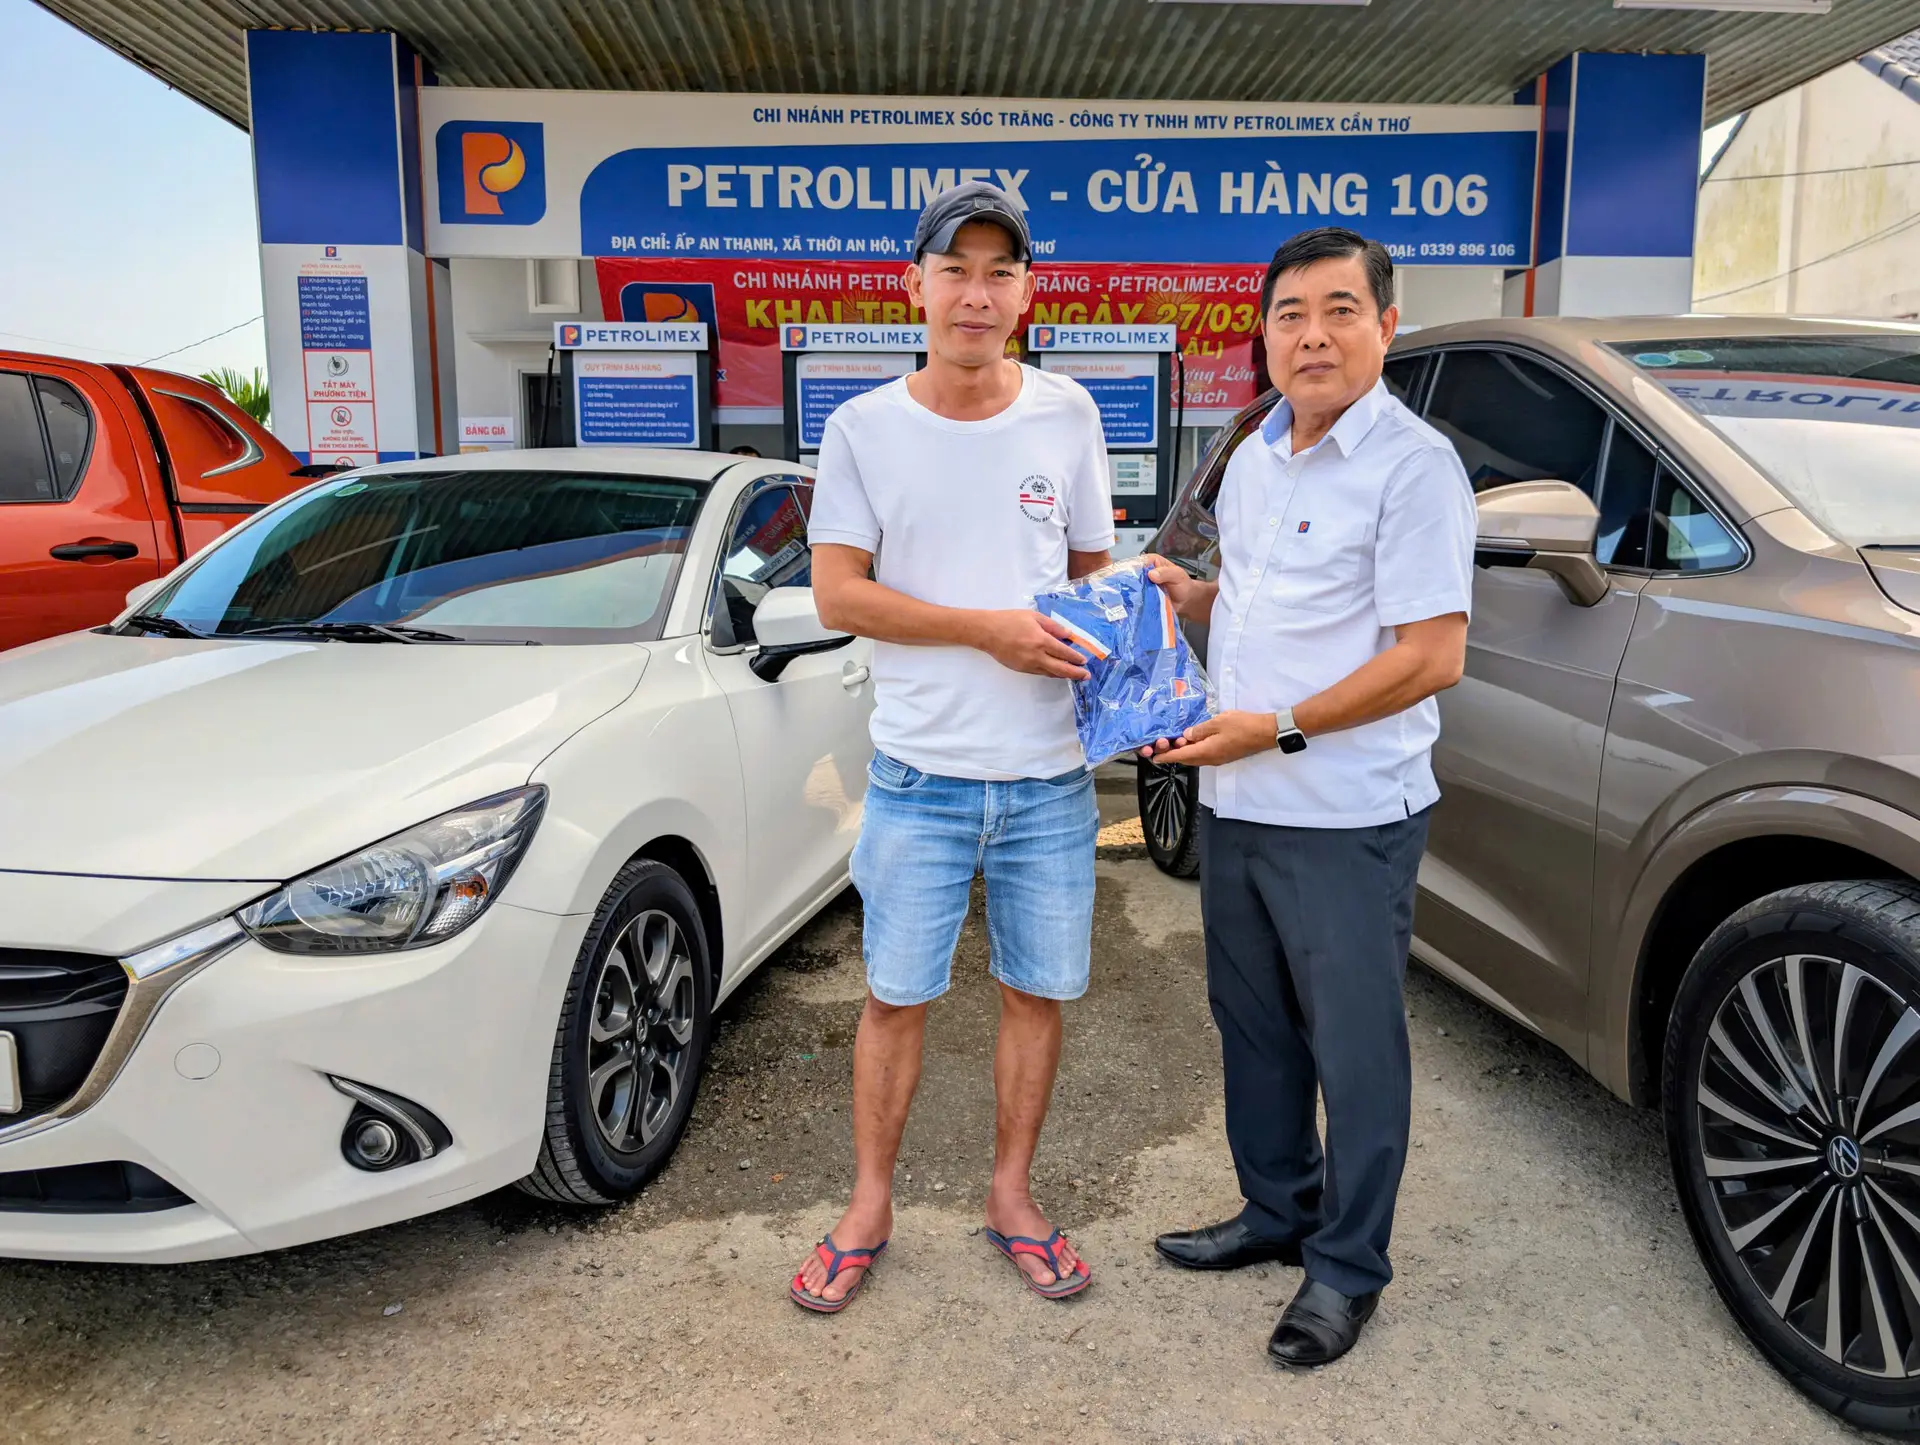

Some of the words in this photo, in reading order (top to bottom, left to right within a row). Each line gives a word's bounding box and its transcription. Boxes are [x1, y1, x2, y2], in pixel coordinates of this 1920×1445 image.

[753, 107, 781, 123] CHI
[787, 105, 844, 124] NHÁNH
[850, 109, 955, 126] PETROLIMEX
[960, 107, 993, 126] SÓC
[999, 111, 1053, 127] TRĂNG
[1069, 110, 1114, 128] CÔNG
[1121, 113, 1139, 128] TY
[1145, 114, 1188, 129] TNHH
[1194, 115, 1228, 130] MTV
[1234, 116, 1335, 132] PETROLIMEX
[1340, 112, 1372, 132] CẦN
[1378, 116, 1411, 133] THƠ
[1087, 152, 1199, 214] CỬA
[1219, 160, 1368, 216] HÀNG
[1390, 174, 1488, 217] 106
[611, 236, 636, 251] ĐỊA
[640, 233, 671, 250] CHỈ:
[675, 232, 695, 251] ẤP
[699, 237, 719, 251] AN
[723, 237, 779, 253] THẠNH,
[782, 235, 801, 251] XÃ
[807, 236, 841, 252] THỚI
[846, 238, 865, 252] AN
[870, 237, 900, 255] HỘI,
[1386, 243, 1416, 259] OẠI:
[1420, 243, 1455, 256] 0339
[1459, 243, 1485, 256] 896
[1489, 243, 1516, 256] 106
[733, 271, 767, 289] CHI
[773, 268, 842, 290] NHÁNH
[848, 273, 908, 291] PETRO
[1035, 271, 1090, 293] RĂNG
[1108, 272, 1264, 294] PETROLIMEX-CỬ
[745, 299, 843, 329] KHAI
[1034, 294, 1145, 325] NGÀY
[586, 329, 701, 343] PETROLIMEX
[811, 331, 924, 345] PETROLIMEX
[1059, 331, 1170, 345] PETROLIMEX
[340, 380, 356, 388] MÁY
[348, 389, 366, 398] TIỆN
[465, 422, 489, 435] BẢNG
[491, 423, 506, 435] GIÁ
